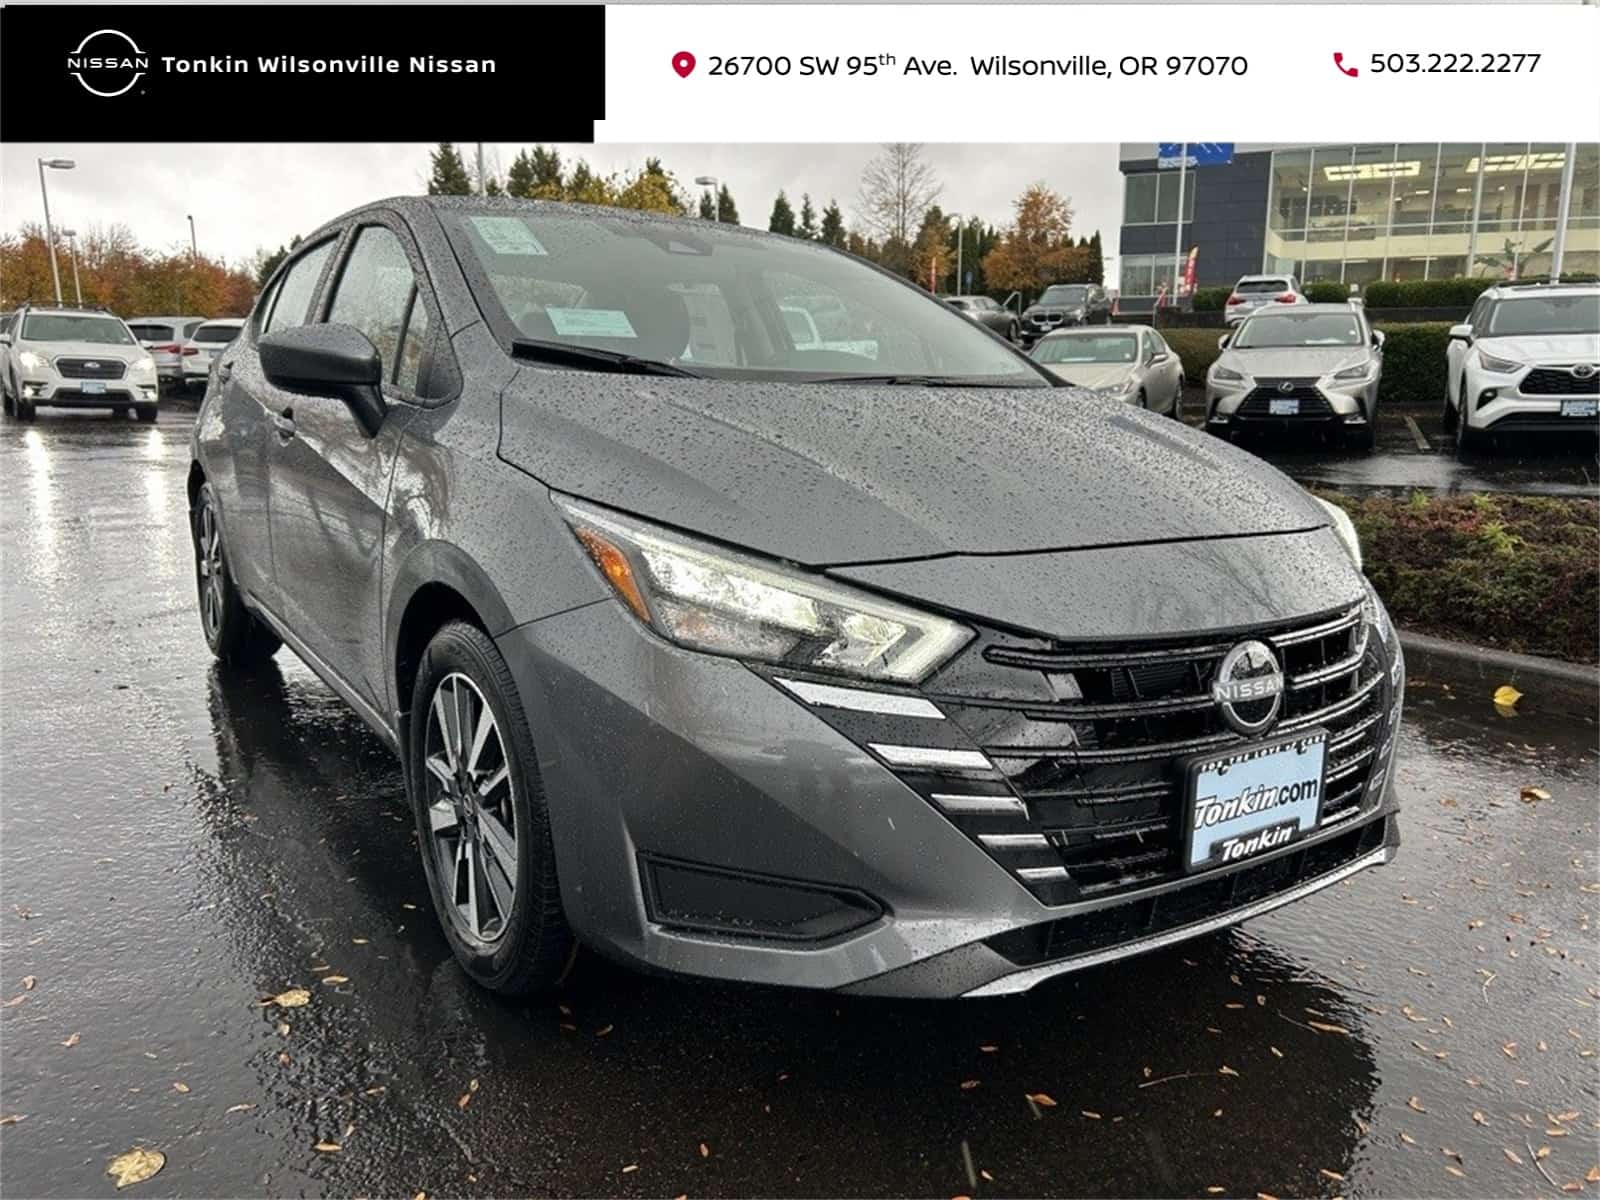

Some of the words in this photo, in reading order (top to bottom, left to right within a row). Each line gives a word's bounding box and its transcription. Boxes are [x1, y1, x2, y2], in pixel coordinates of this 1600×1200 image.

[1215, 678, 1283, 700] NISSAN
[1194, 778, 1318, 830] Tonkin.com
[1221, 827, 1293, 861] Tonkin
